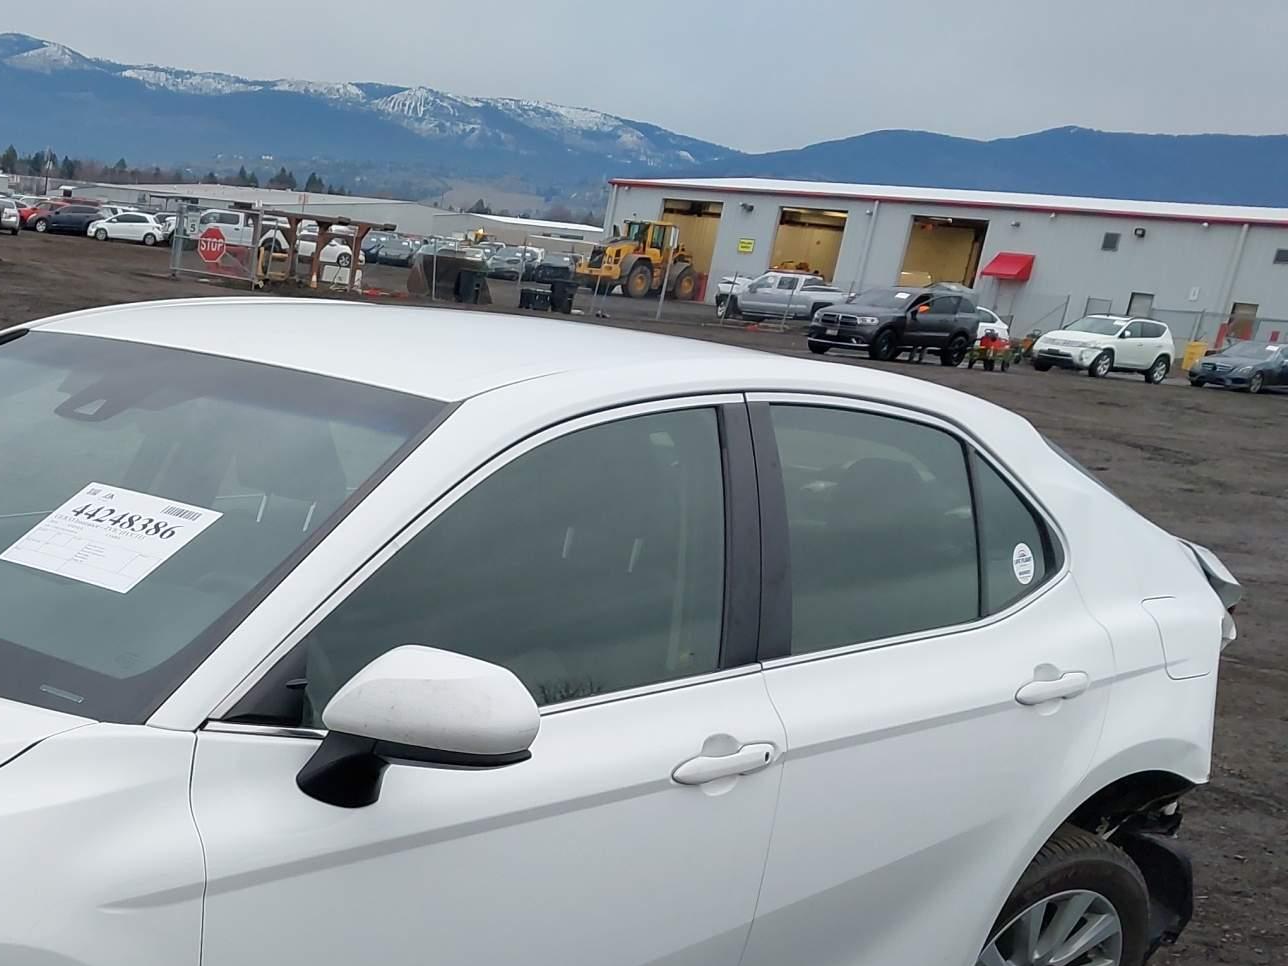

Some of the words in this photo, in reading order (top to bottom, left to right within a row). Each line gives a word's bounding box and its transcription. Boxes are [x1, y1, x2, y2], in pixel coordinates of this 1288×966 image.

[189, 223, 196, 233] 5
[200, 238, 224, 251] STOP
[71, 503, 185, 540] 44248386
